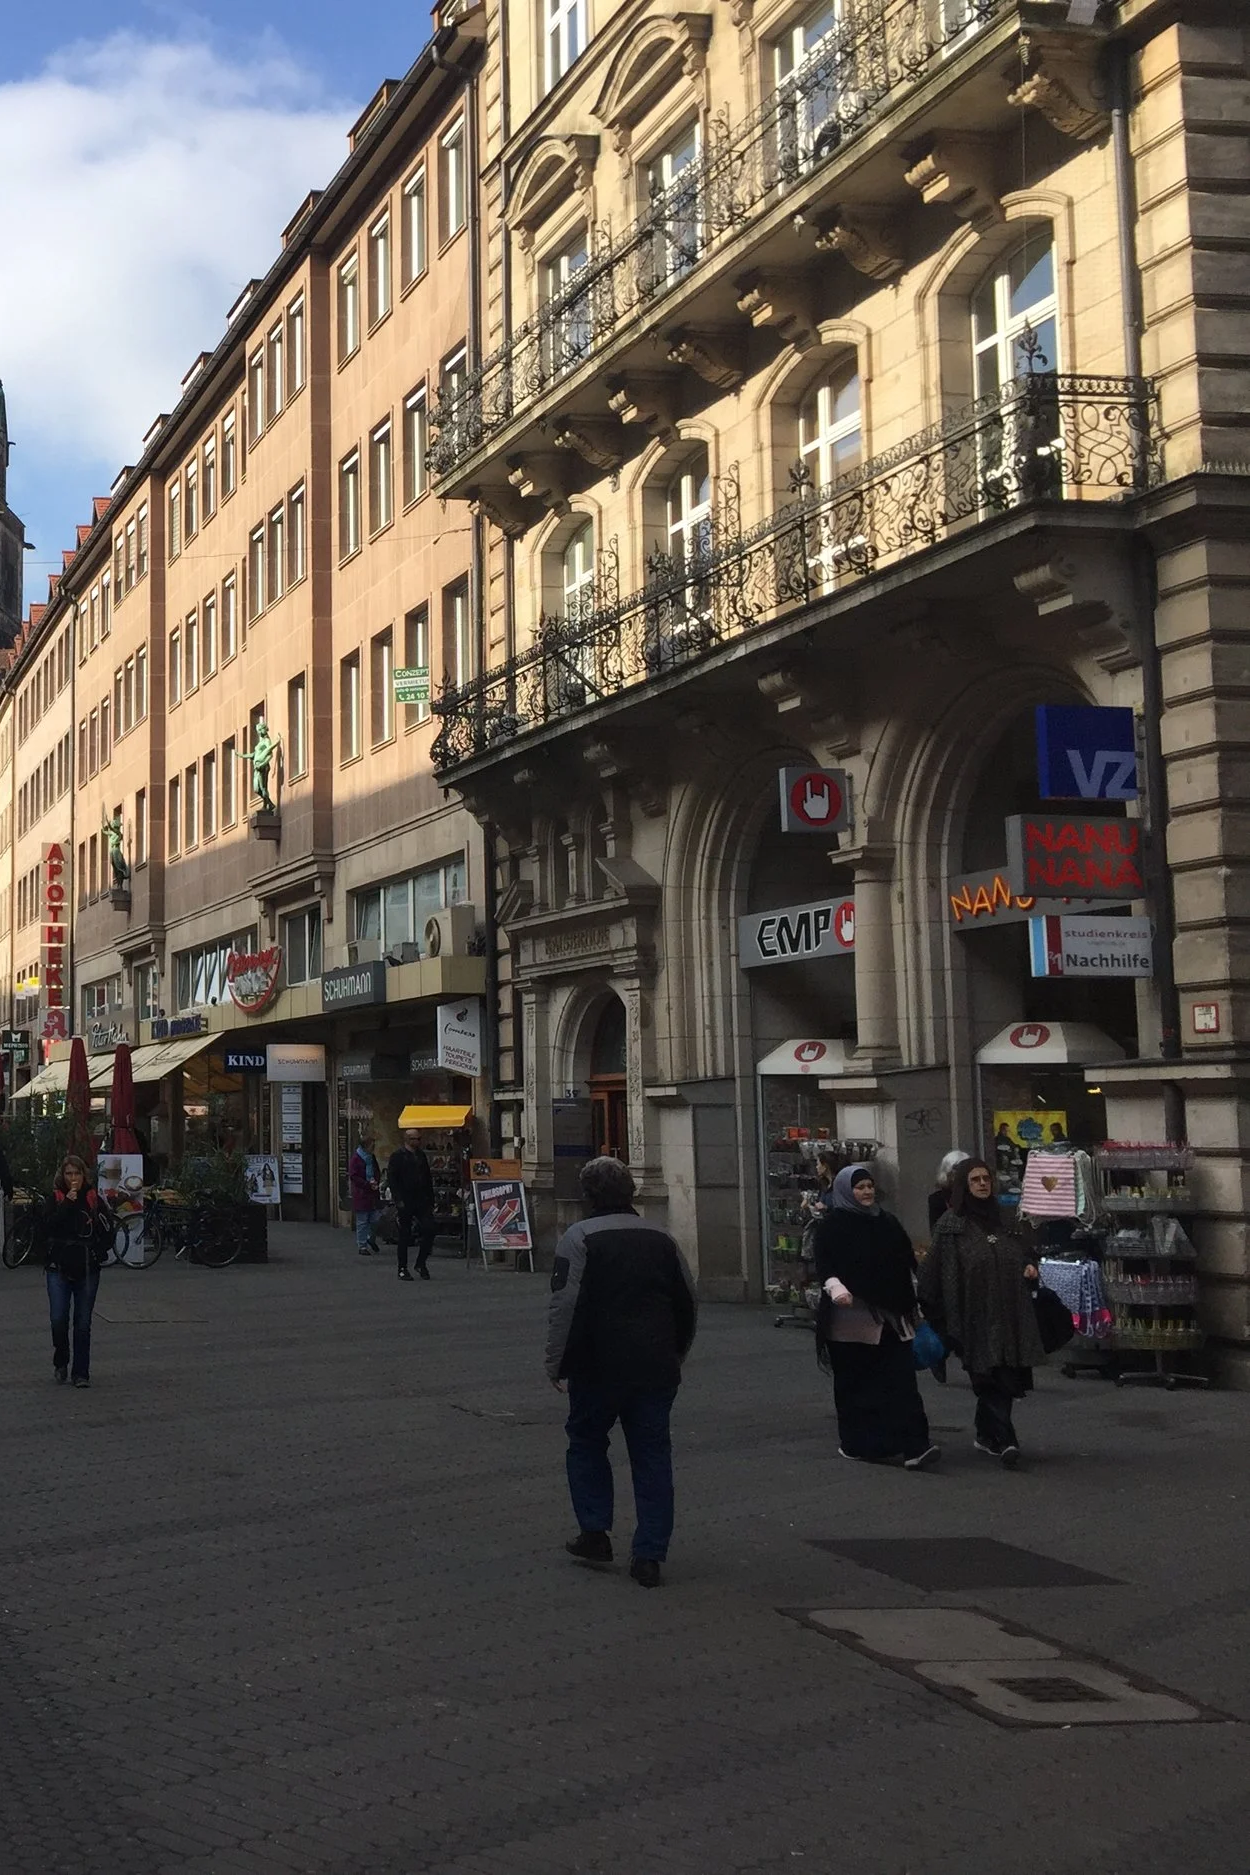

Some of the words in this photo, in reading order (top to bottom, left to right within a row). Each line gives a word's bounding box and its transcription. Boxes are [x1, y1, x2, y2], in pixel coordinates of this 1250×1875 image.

[1025, 822, 1139, 855] NANU
[1026, 857, 1143, 889] NANA
[46, 843, 66, 1007] APOTHEKE
[756, 906, 833, 959] EMP
[1064, 929, 1149, 939] studienkreis
[1065, 953, 1150, 969] Nachhilfe
[324, 972, 372, 1002] SCHUHMANN
[227, 1054, 265, 1067] KIND
